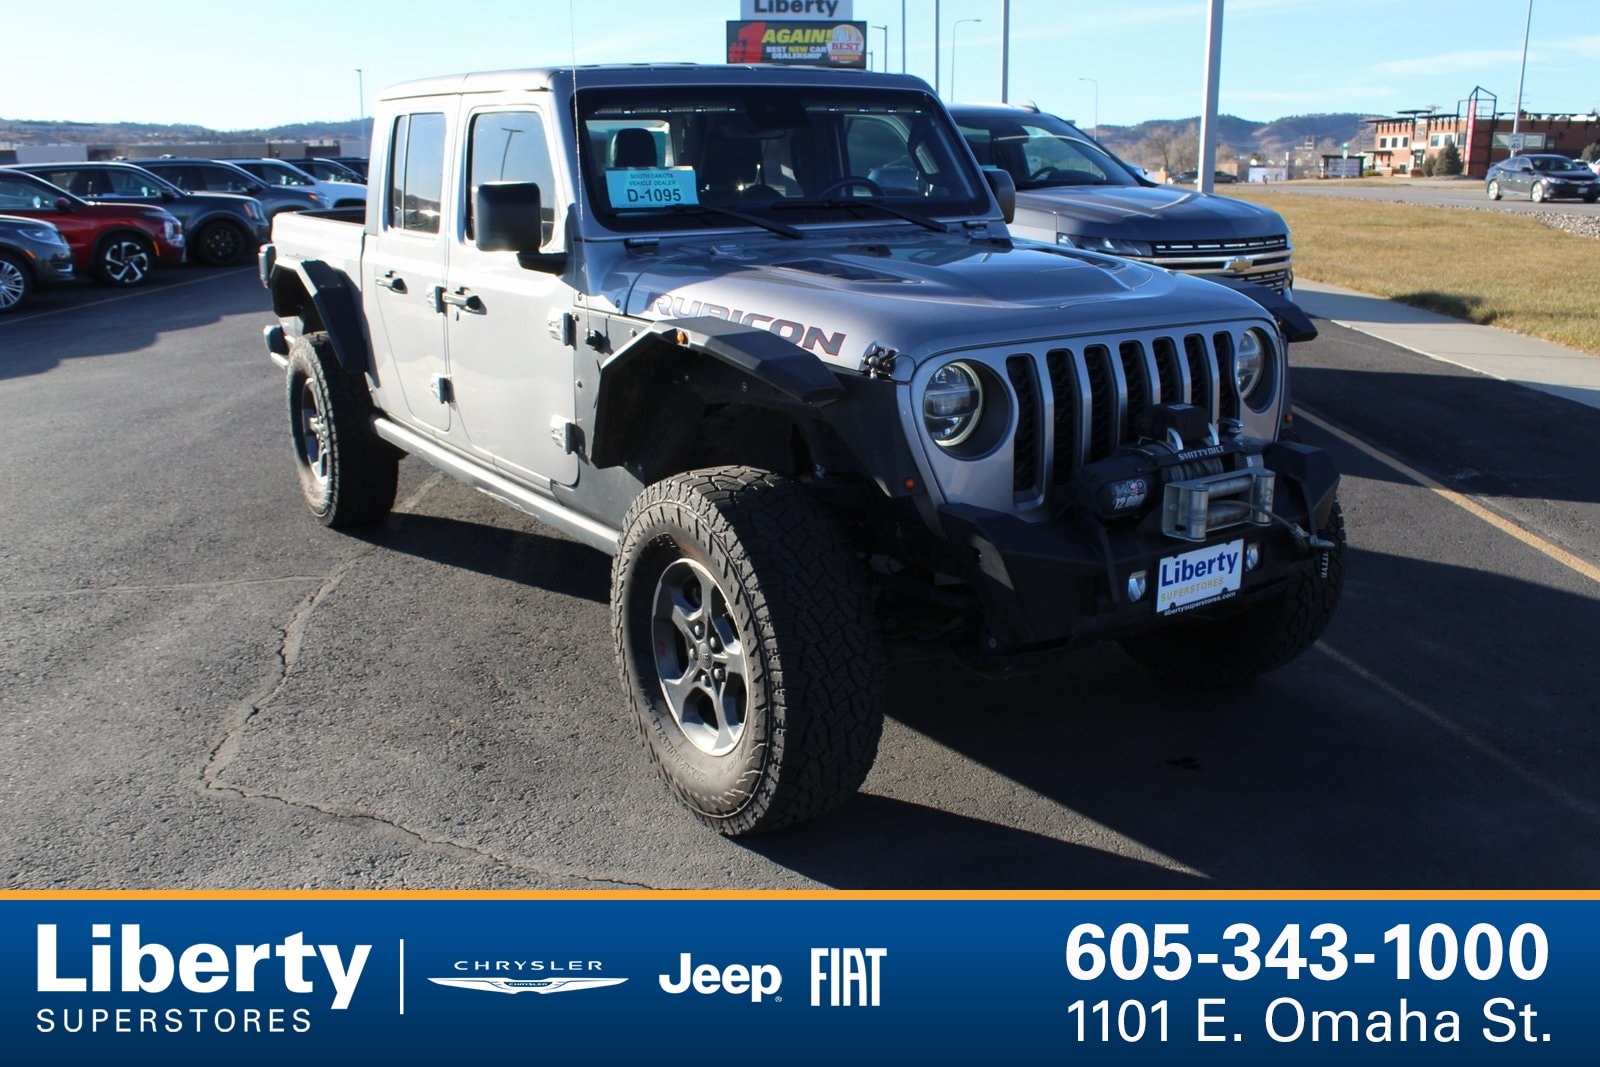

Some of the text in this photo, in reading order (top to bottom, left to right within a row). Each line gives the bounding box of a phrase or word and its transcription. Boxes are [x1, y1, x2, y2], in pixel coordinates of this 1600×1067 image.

[754, 0, 838, 17] Liberty
[762, 29, 832, 43] AGAIN!
[772, 52, 822, 60] DEALERSHIP
[627, 188, 682, 202] D-1095
[650, 294, 847, 357] RUBICON
[1178, 445, 1225, 461] SMITTYBILT
[1161, 551, 1239, 587] Liberty
[1160, 576, 1225, 602] SUPERSTORES
[1164, 591, 1236, 616] libertysuperstores.com
